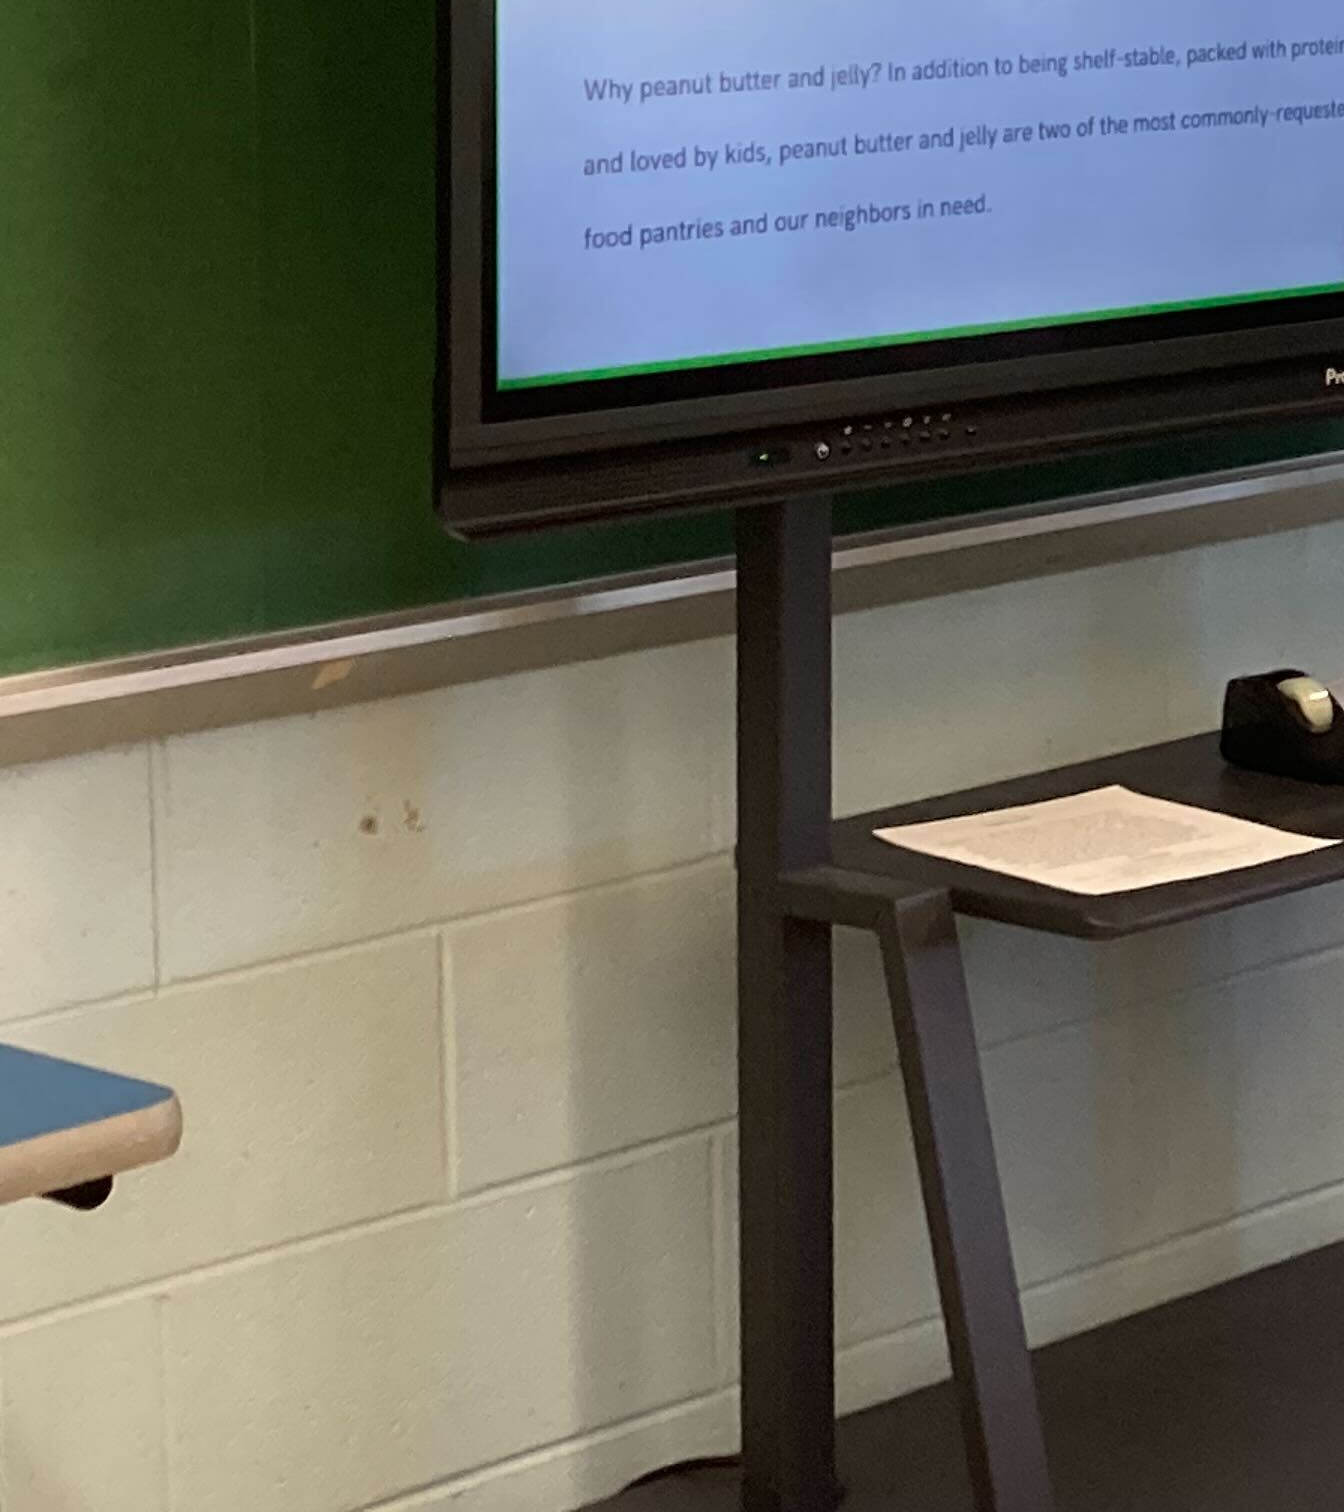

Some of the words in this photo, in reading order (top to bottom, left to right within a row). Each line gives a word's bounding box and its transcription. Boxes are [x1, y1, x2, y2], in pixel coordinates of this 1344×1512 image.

[584, 77, 634, 105] Why
[639, 76, 714, 104] peanut
[719, 69, 781, 95] butter
[788, 65, 825, 90] and
[829, 61, 882, 93] jelly?
[887, 61, 907, 84] In
[911, 57, 989, 82] addition
[994, 55, 1014, 77] to
[1018, 51, 1069, 78] being
[1073, 46, 1183, 72] shelf-stable,
[1186, 42, 1247, 70] packed
[1252, 38, 1288, 61] with
[583, 151, 623, 177] and
[629, 146, 687, 172] loved
[693, 144, 719, 172] by
[725, 139, 773, 167] kids,
[778, 136, 849, 167] peanut
[854, 131, 912, 156] butter
[919, 127, 955, 151] and
[958, 123, 998, 153] jelly
[1002, 124, 1033, 143] are
[1038, 119, 1071, 141] two
[1076, 116, 1095, 138] of
[1099, 113, 1129, 136] the
[1133, 112, 1176, 134] most
[584, 224, 633, 251] food
[639, 216, 725, 251] pantries
[729, 213, 768, 237] and
[774, 212, 809, 232] our
[814, 202, 911, 232] neighbors
[916, 198, 936, 220] in
[940, 193, 992, 217] need.
